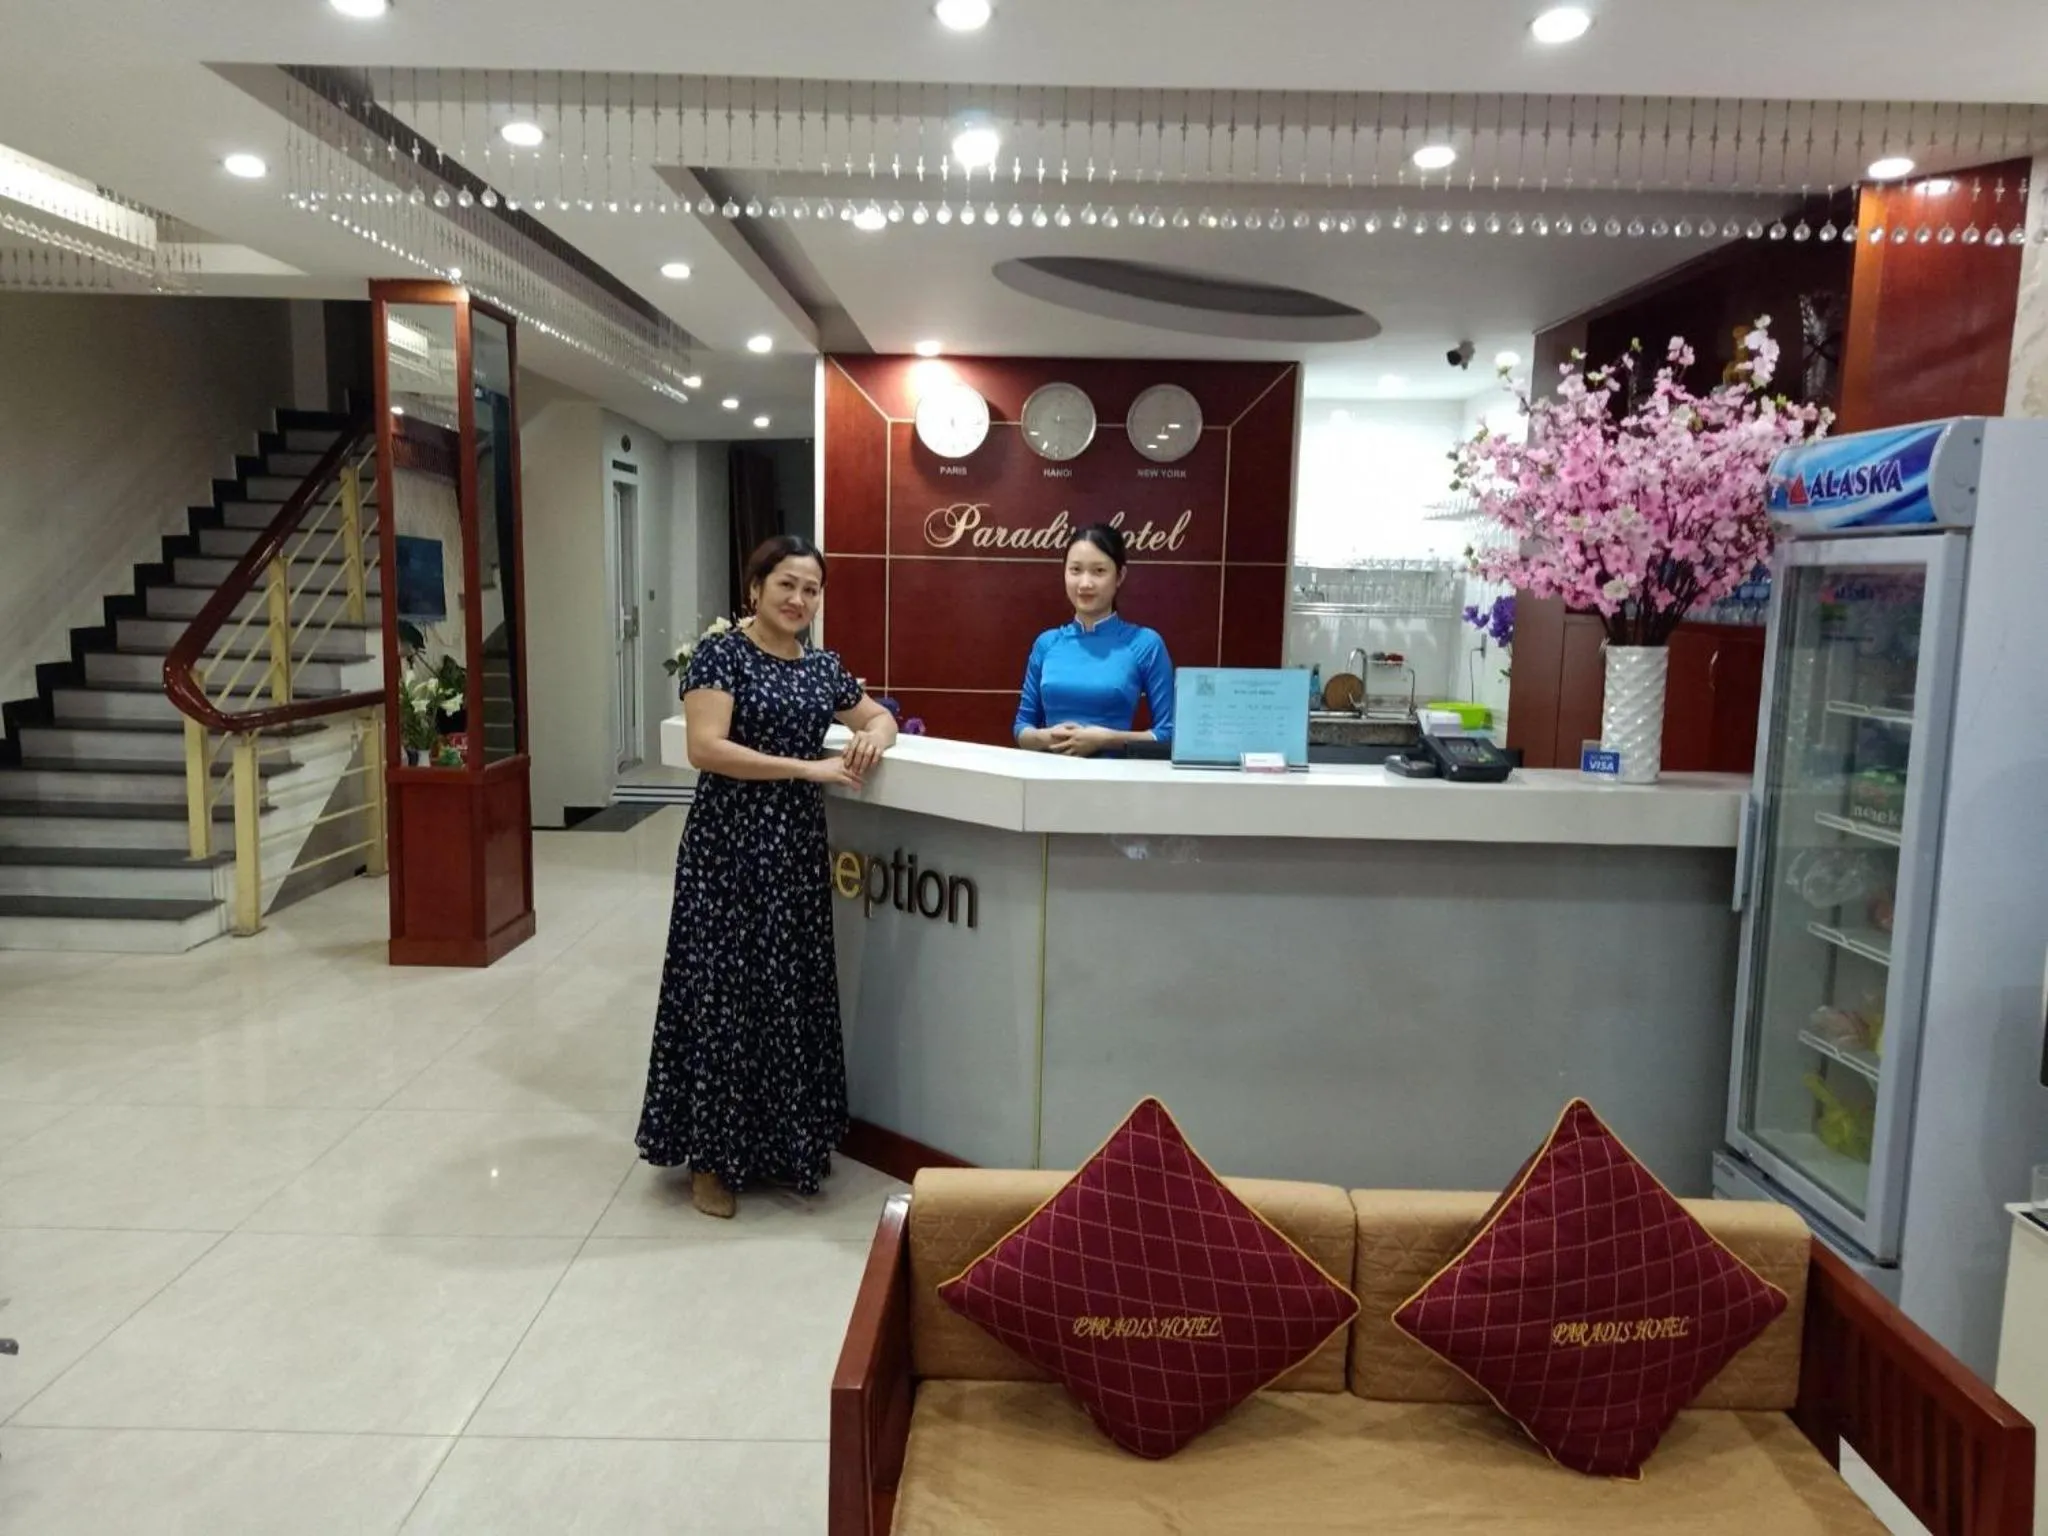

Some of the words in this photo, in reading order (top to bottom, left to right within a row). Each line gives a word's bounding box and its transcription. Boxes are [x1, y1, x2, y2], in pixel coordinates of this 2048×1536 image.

[940, 466, 968, 476] PARIS
[1043, 468, 1073, 478] HANOI
[1137, 468, 1159, 479] NEW
[1161, 469, 1187, 479] YORK
[1811, 461, 1903, 499] ALASKA
[924, 503, 1076, 549] Paradi
[1589, 760, 1614, 771] VISA
[835, 848, 978, 929] eption
[1073, 1316, 1156, 1340] PARADIS
[1157, 1316, 1222, 1338] HOTEL
[1552, 1321, 1633, 1347] PARADIS
[1633, 1316, 1690, 1341] HOTEL
